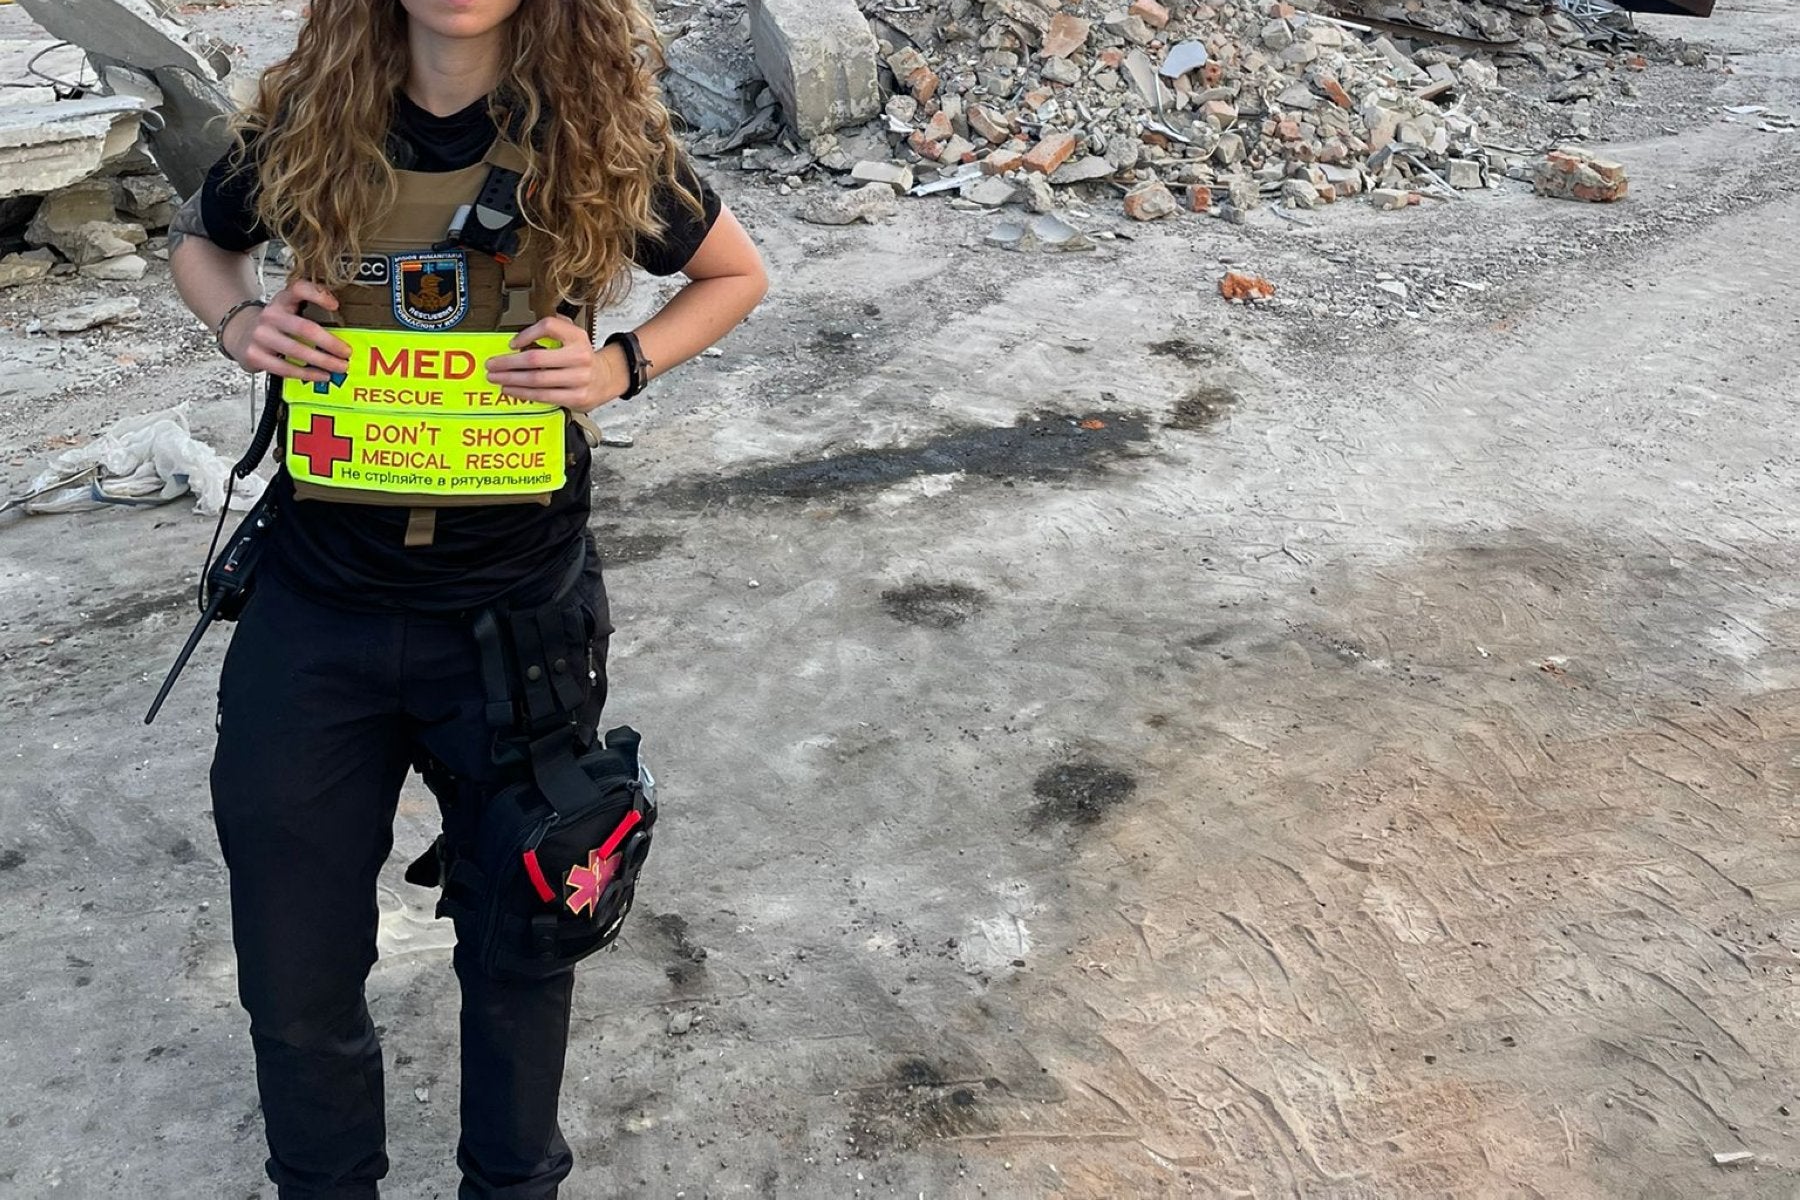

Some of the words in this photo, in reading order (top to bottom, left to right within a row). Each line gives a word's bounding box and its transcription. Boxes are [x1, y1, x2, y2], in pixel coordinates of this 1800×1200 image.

[369, 346, 476, 380] MED
[353, 388, 443, 405] RESCUE
[365, 422, 441, 446] DON'T
[462, 427, 544, 447] SHOOT
[361, 449, 451, 469] MEDICAL
[466, 452, 546, 469] RESCUE
[341, 467, 360, 480] Не
[365, 471, 433, 486] стріляйте
[437, 476, 446, 486] в
[451, 472, 552, 488] рятувальників
